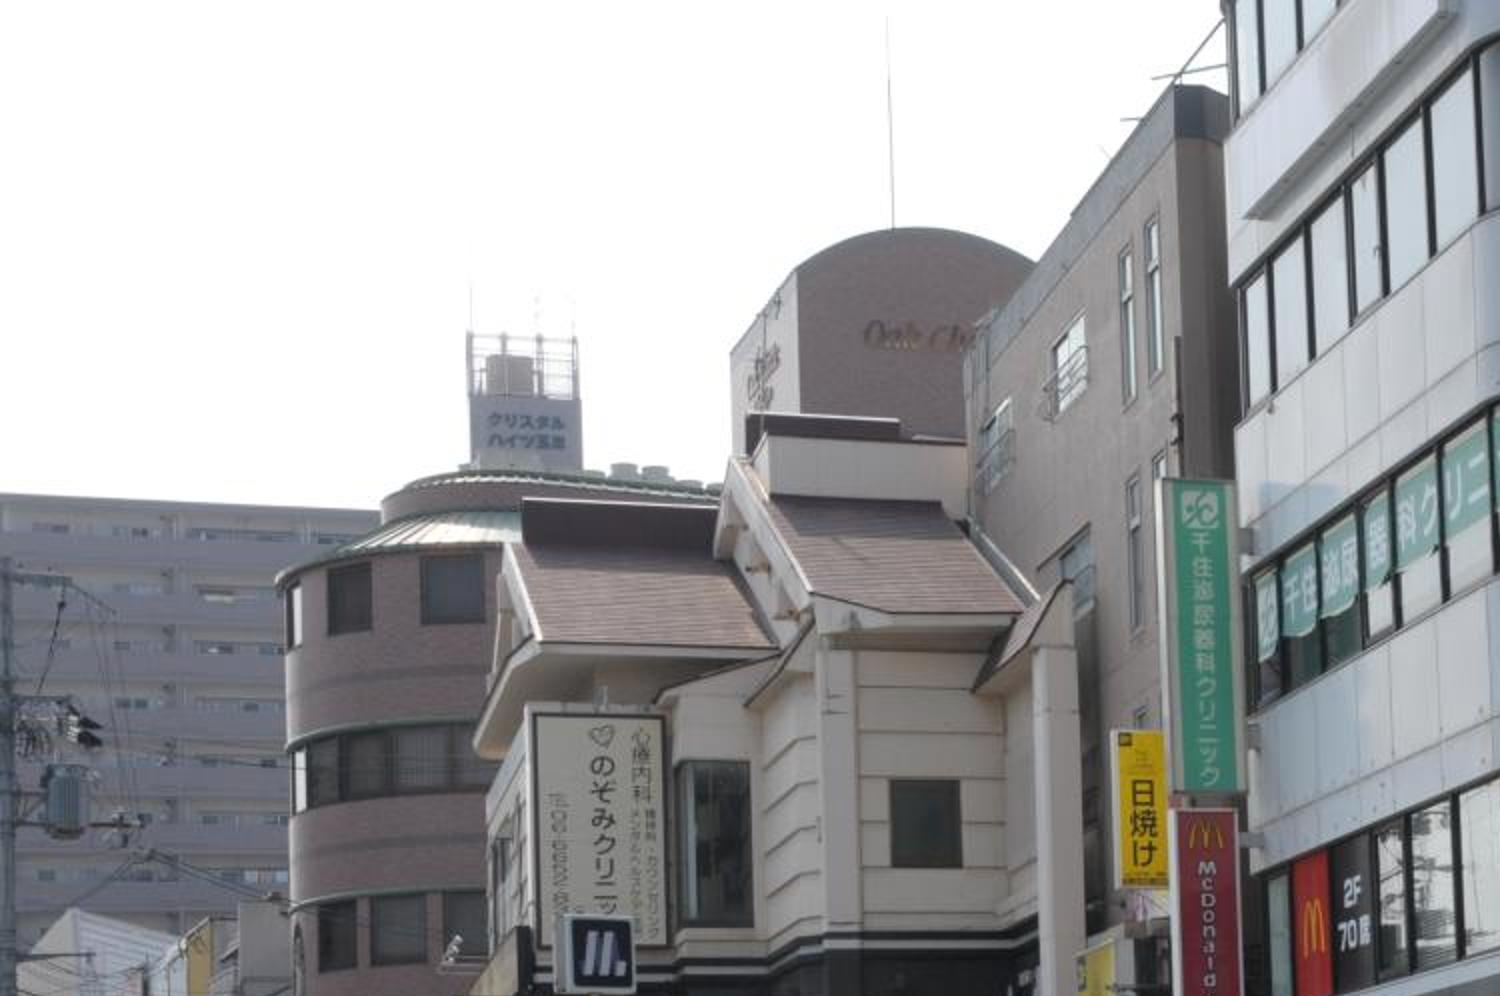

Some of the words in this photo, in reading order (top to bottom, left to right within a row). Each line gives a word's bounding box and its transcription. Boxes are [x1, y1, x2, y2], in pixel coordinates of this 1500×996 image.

[589, 755, 618, 916] のぞみクリニッ
[1129, 779, 1159, 867] 日焼け
